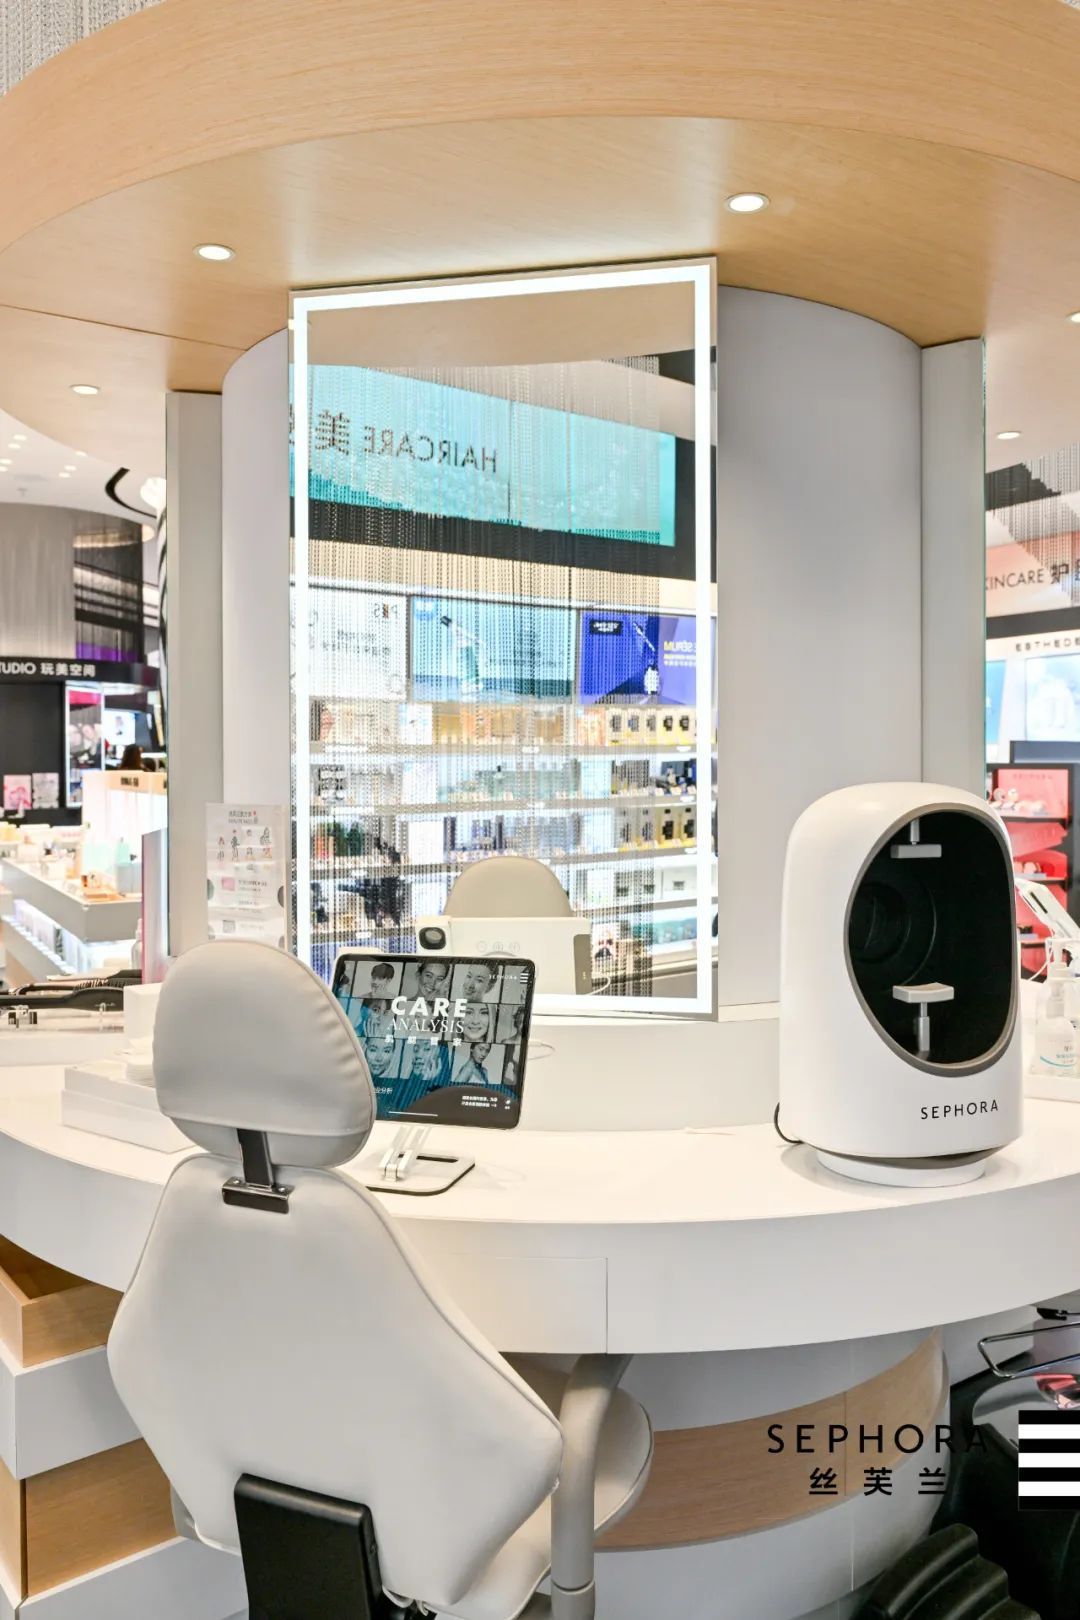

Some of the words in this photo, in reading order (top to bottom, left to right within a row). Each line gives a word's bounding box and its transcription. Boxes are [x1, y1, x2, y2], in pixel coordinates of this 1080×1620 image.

[1051, 559, 1080, 585] 护
[40, 662, 96, 678] 玩美空间
[391, 995, 468, 1018] CARE
[387, 1017, 465, 1034] ANALYSIS
[920, 1099, 999, 1120] SEPHORA
